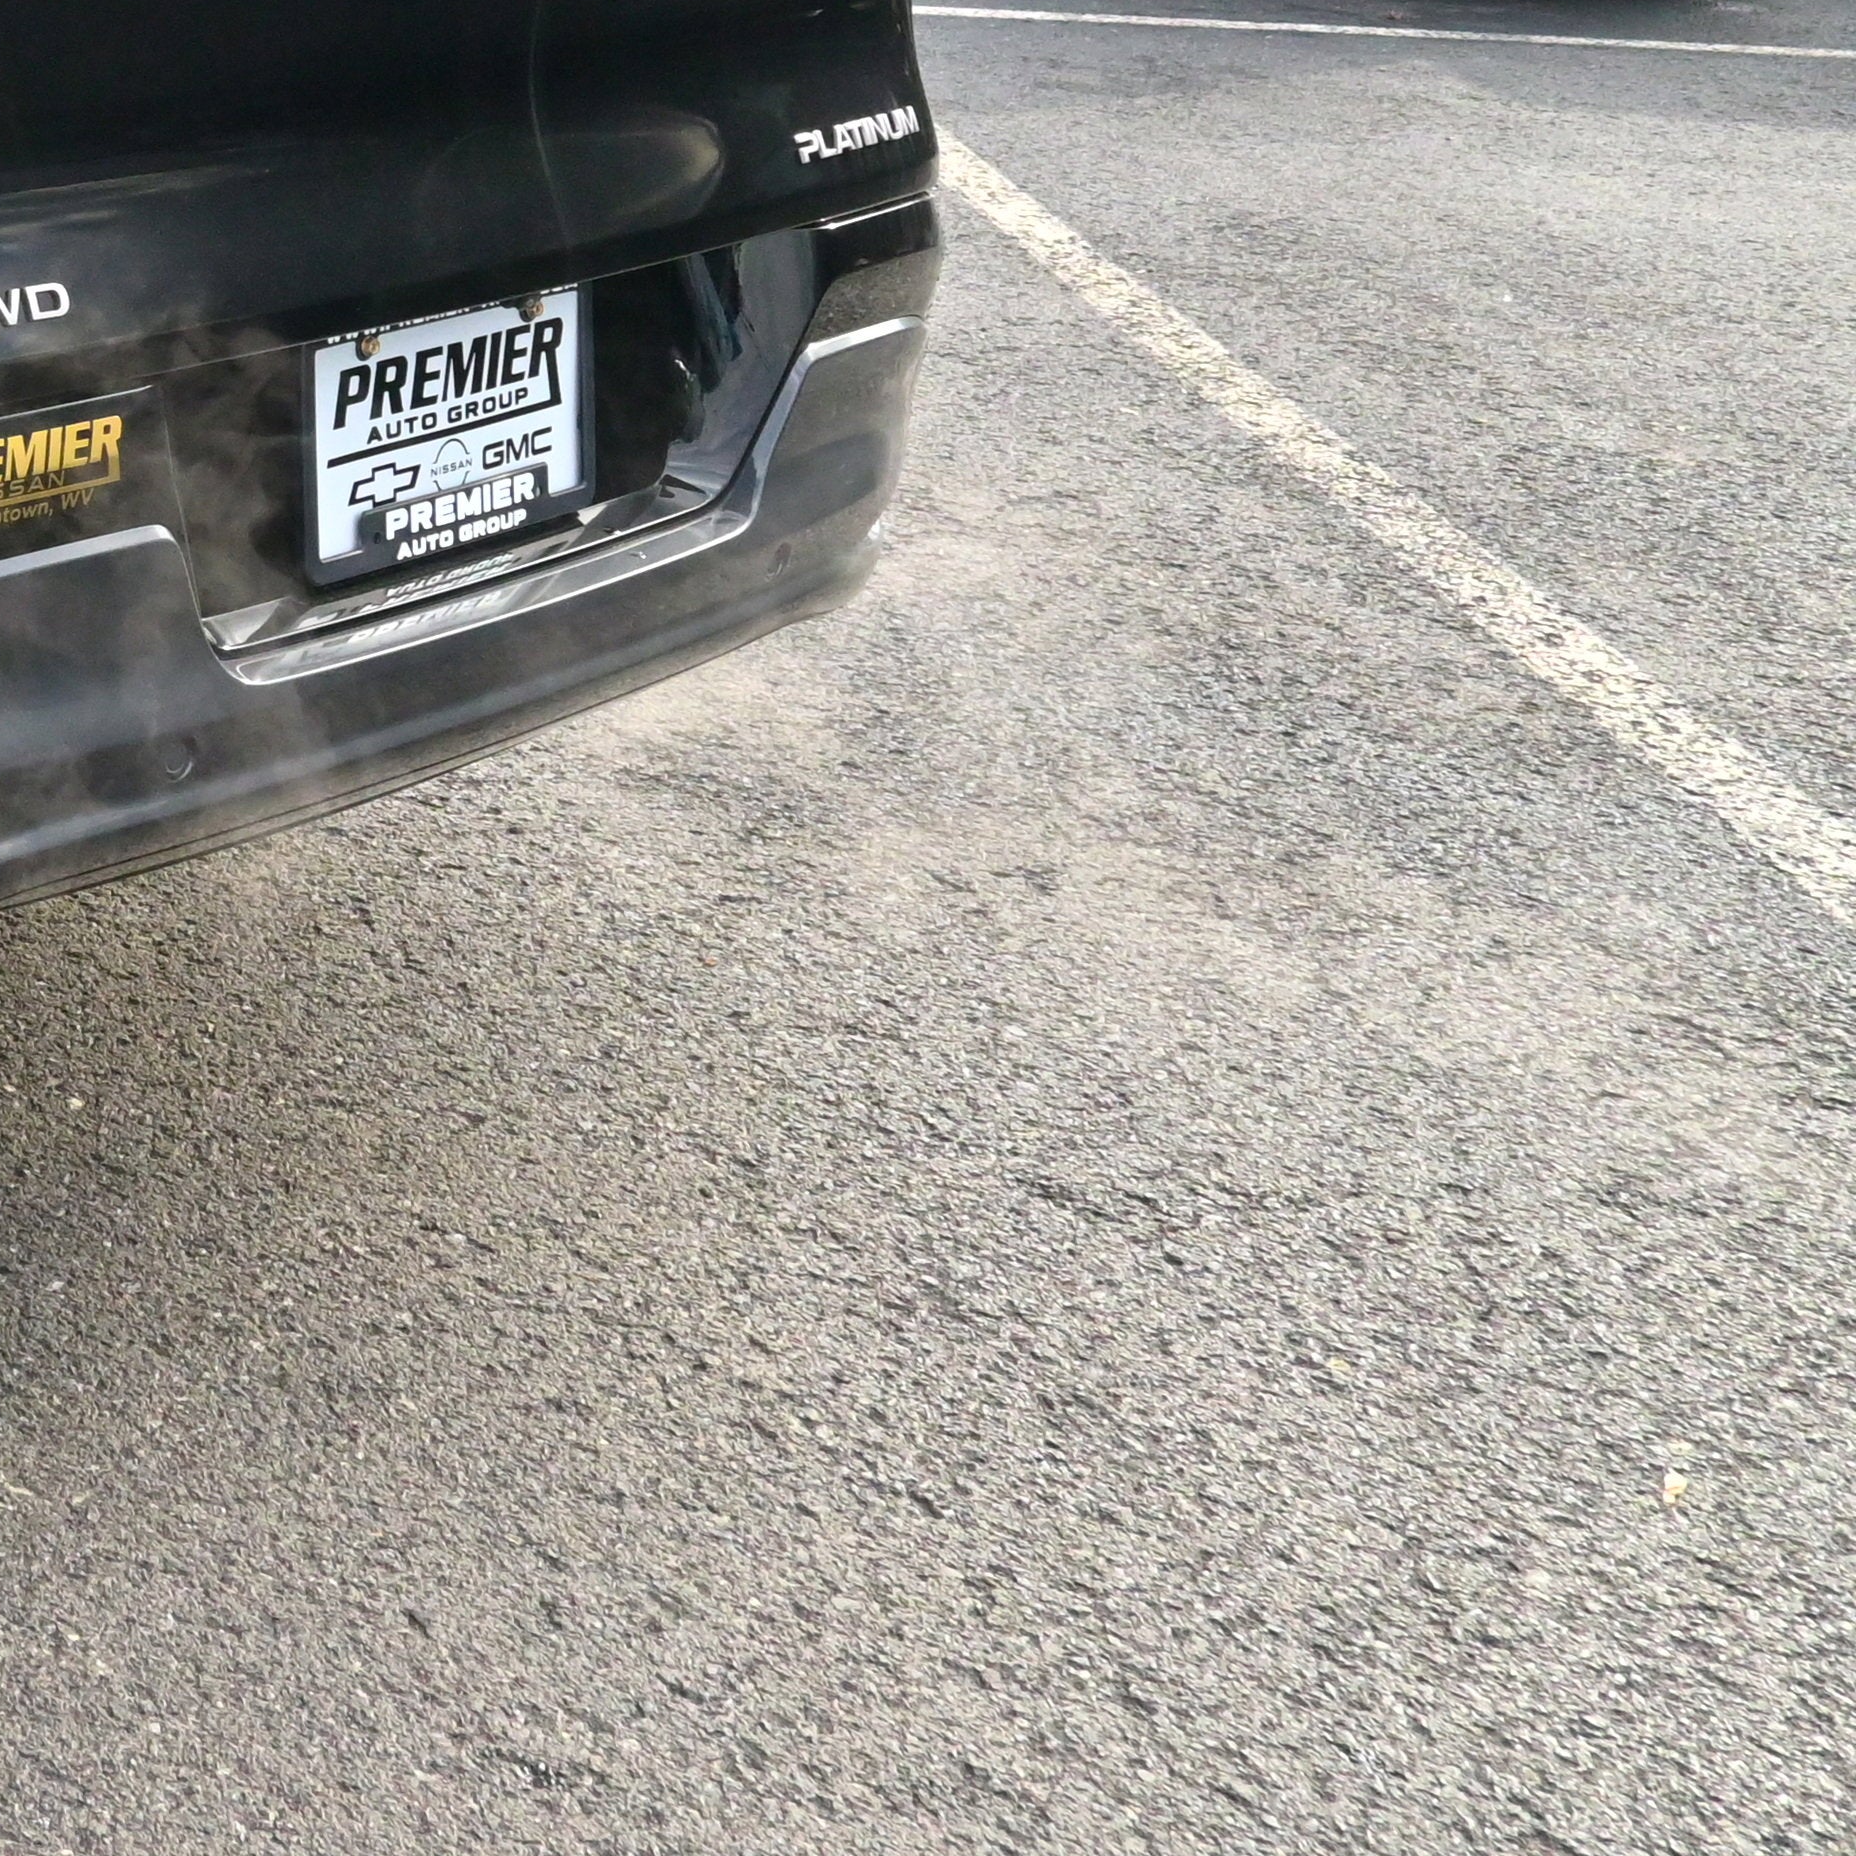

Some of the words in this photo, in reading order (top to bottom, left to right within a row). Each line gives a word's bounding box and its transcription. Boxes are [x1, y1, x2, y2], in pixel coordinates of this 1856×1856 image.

[793, 104, 920, 164] PLATINUM
[333, 316, 563, 431] PREMIER
[367, 411, 437, 445] AUTO
[447, 387, 529, 424] GROUP
[430, 458, 473, 478] NISSAN
[482, 426, 553, 471] GMC
[60, 488, 95, 511] WV
[385, 472, 535, 541] PREMIER
[397, 531, 454, 560] AUTO
[459, 508, 527, 542] GROUP
